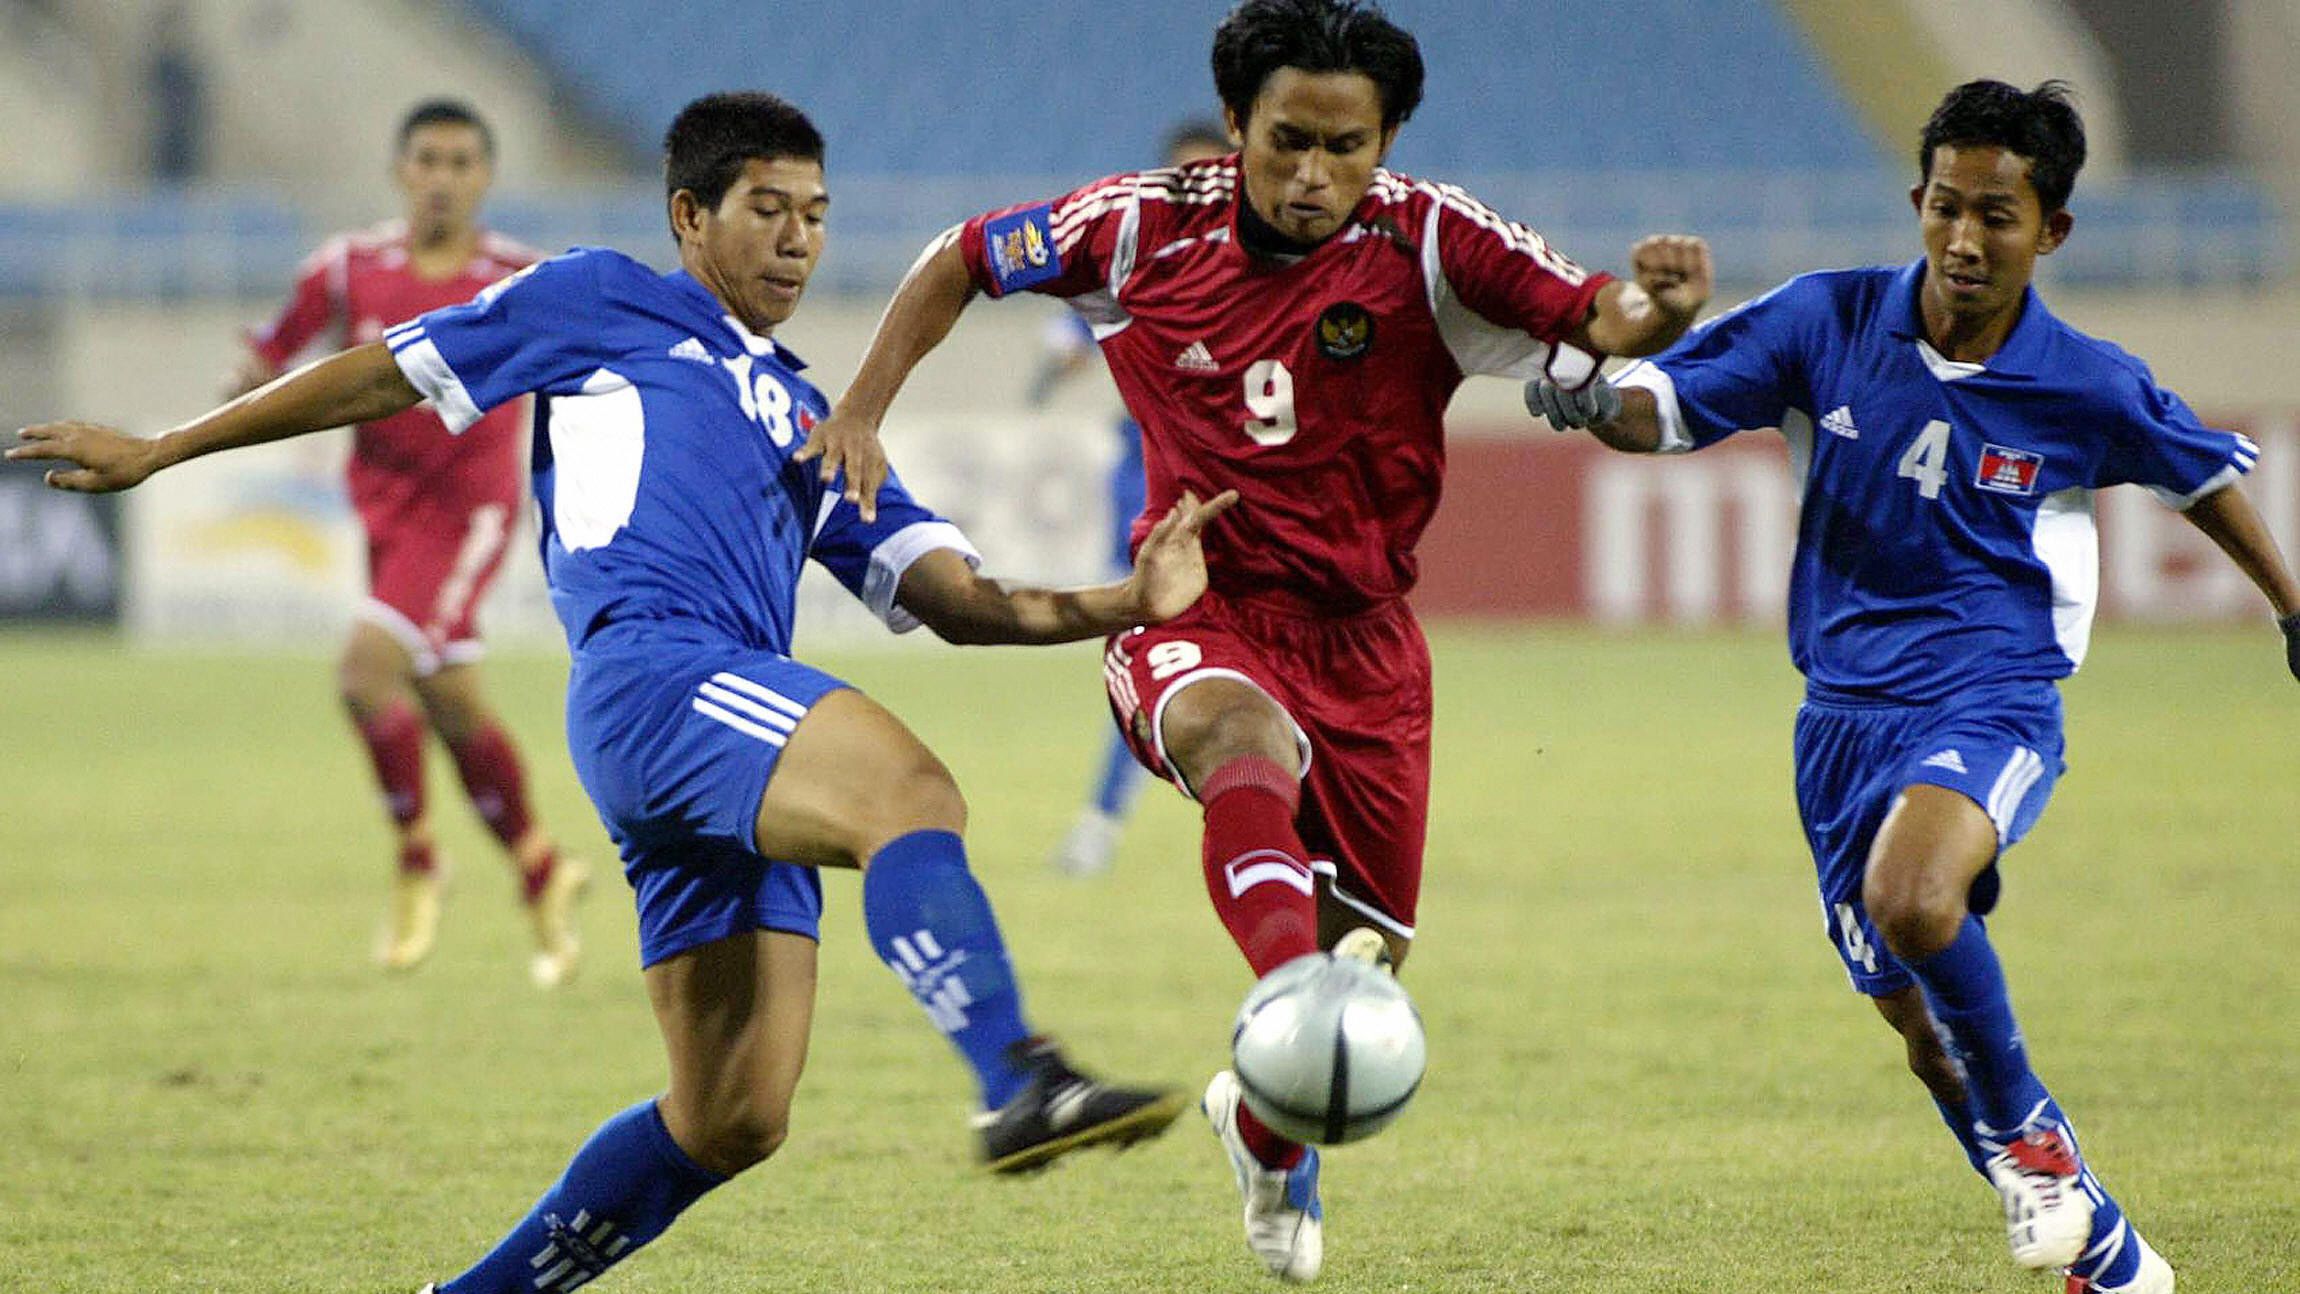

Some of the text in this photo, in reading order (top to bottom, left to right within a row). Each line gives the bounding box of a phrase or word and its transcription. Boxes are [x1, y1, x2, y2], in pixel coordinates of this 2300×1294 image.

[721, 354, 793, 447] 18
[1243, 359, 1297, 446] 9
[1897, 419, 1951, 500] 4
[1147, 640, 1202, 680] 9
[1834, 902, 1879, 974] 4
